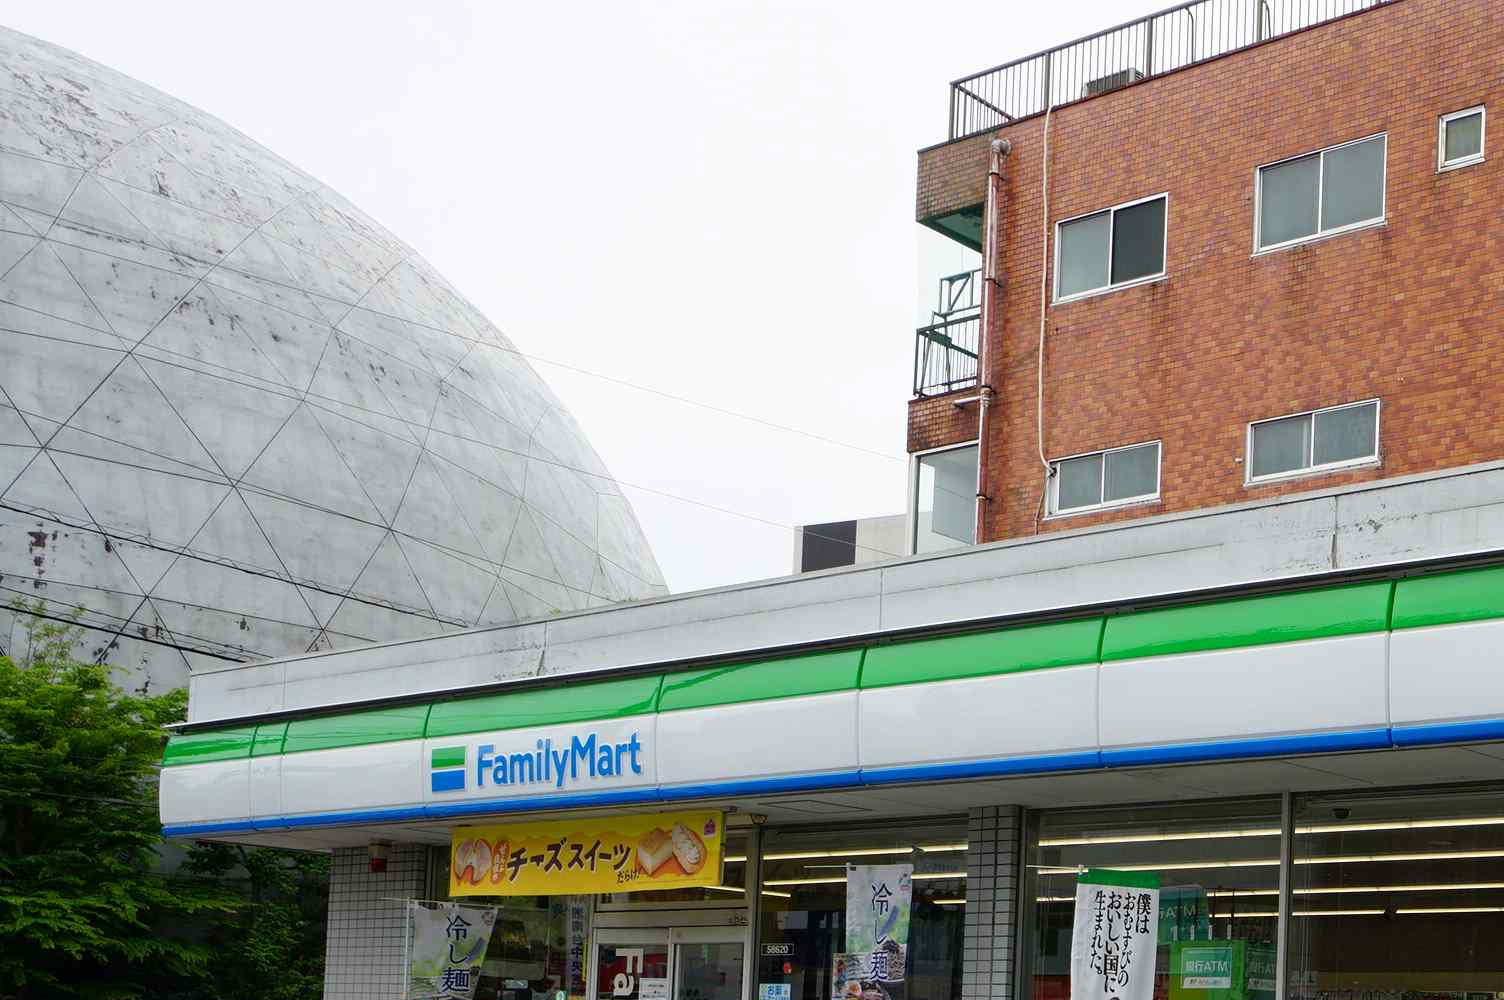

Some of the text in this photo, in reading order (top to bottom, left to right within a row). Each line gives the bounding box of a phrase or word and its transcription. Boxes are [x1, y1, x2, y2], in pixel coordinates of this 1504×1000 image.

[476, 731, 642, 787] FamilyMart
[507, 836, 633, 882] チーズスイーツ
[441, 914, 473, 993] 冷し麺
[871, 882, 893, 982] 冷し麺
[1090, 889, 1108, 975] 生まれた。
[1103, 891, 1122, 993] おいしい国に
[1117, 892, 1137, 987] おむすびの
[1136, 892, 1151, 934] 僕は
